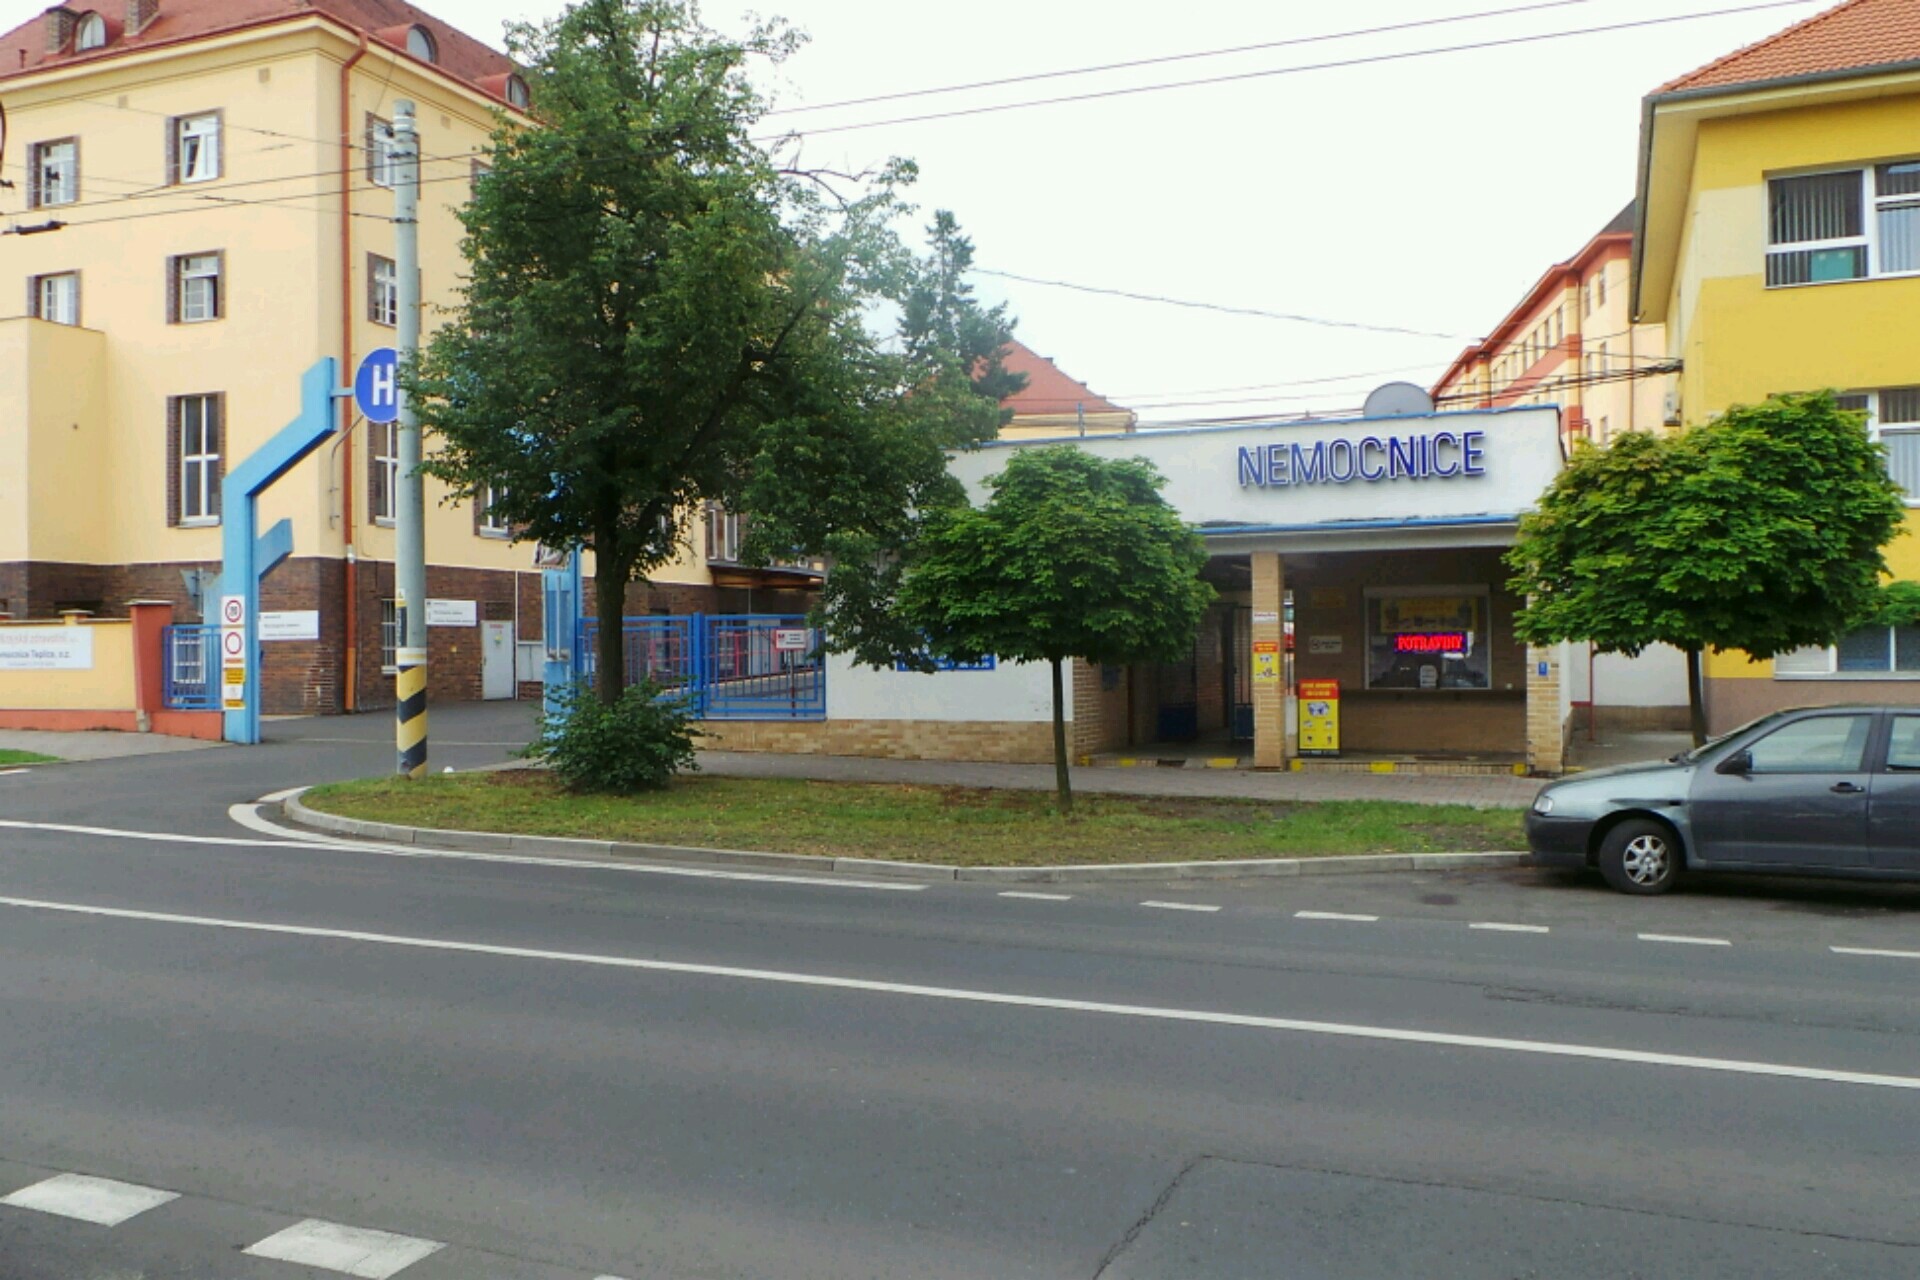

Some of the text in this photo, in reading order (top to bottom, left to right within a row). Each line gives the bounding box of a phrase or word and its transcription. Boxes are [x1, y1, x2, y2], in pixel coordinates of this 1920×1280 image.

[373, 363, 394, 406] H
[1238, 431, 1486, 488] NEMOCNICE
[1398, 635, 1463, 650] POTRAVINY
